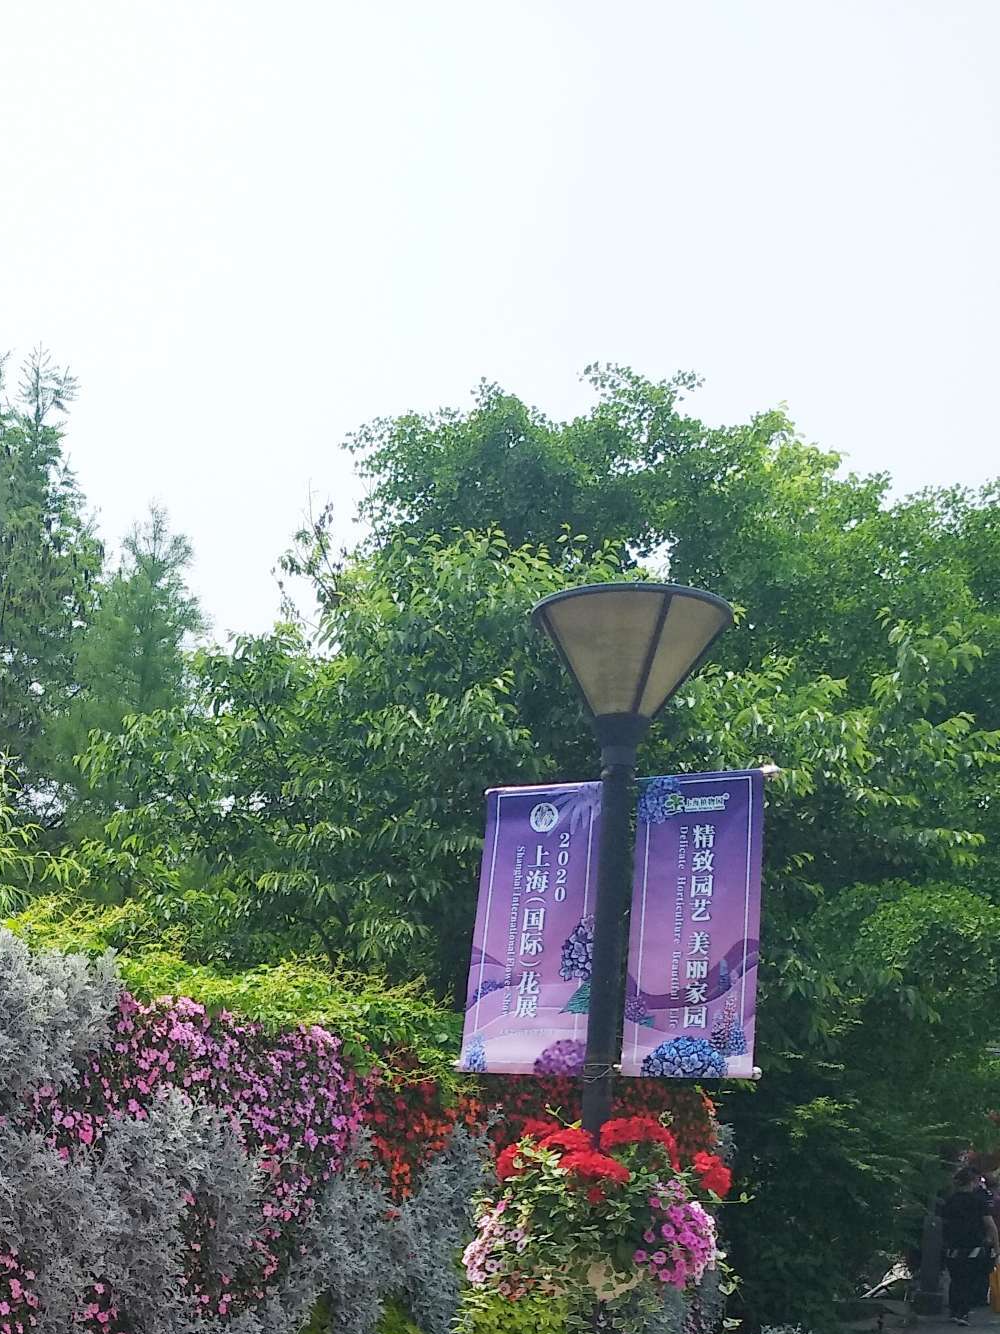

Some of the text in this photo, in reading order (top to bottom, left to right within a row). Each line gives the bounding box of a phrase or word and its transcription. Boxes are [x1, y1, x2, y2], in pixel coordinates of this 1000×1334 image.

[554, 833, 571, 902] 2020
[690, 824, 716, 922] 精致园艺
[501, 846, 526, 1017] Shanghai International Flower Show
[669, 826, 689, 1029] Delicate Horticulture Beautiful Life
[683, 931, 711, 1029] 美丽家园
